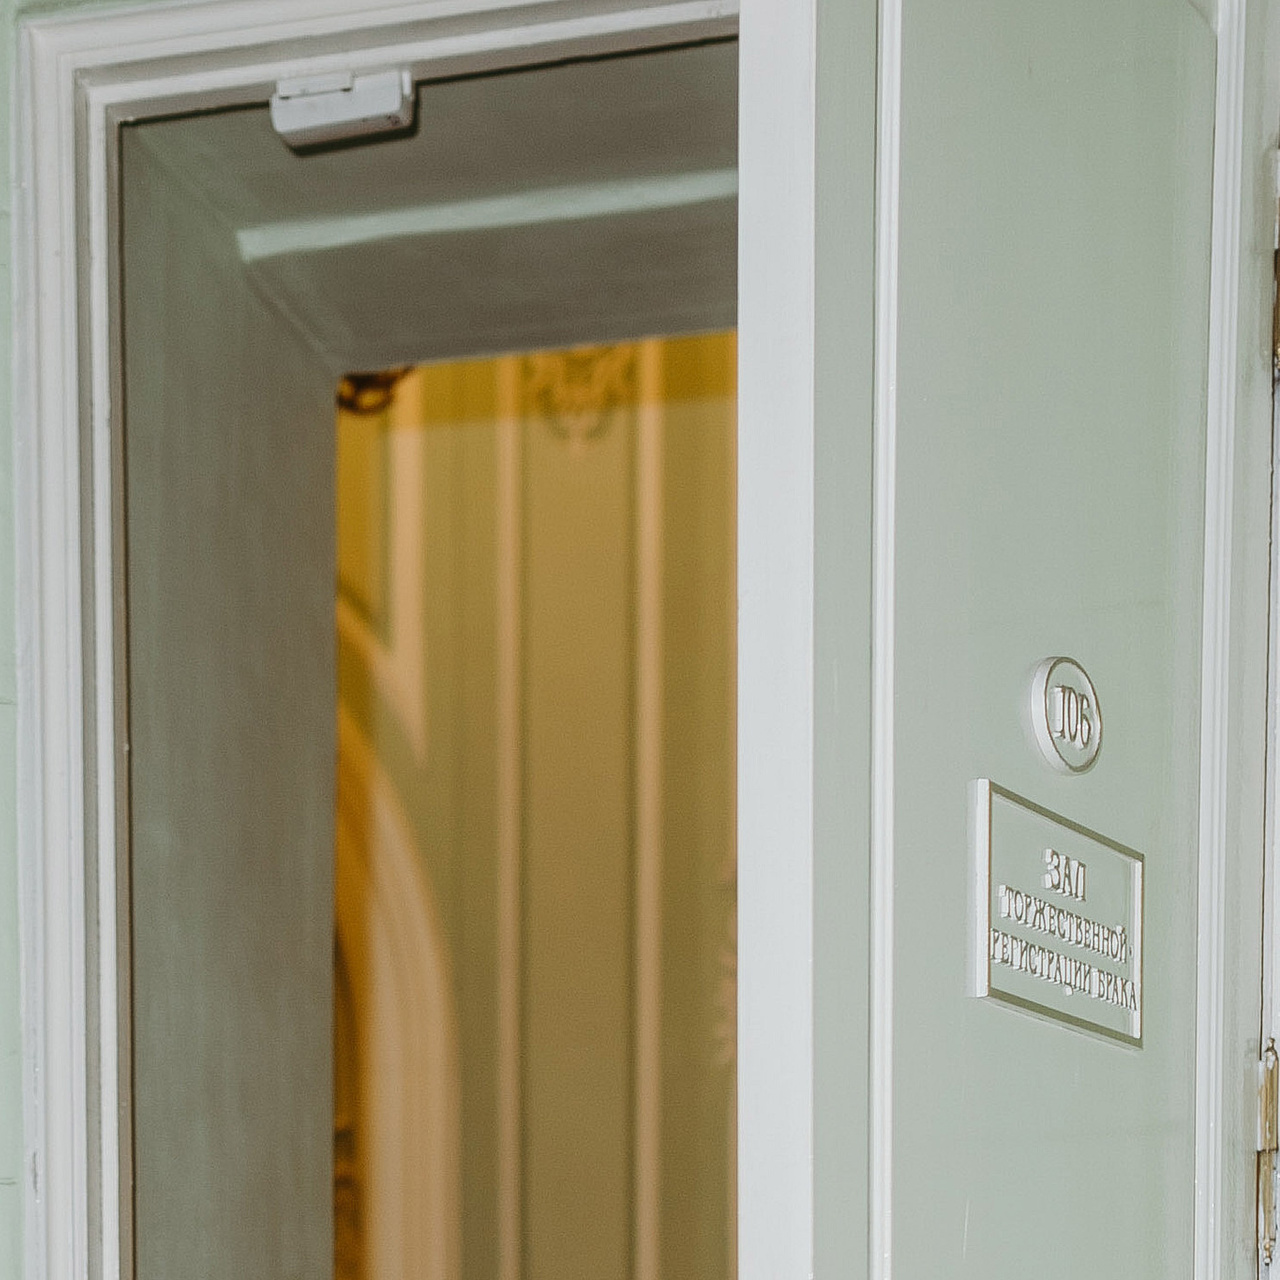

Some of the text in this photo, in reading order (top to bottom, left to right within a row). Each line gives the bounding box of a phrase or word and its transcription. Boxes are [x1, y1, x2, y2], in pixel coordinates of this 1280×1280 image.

[1054, 684, 1091, 750] 106
[1045, 848, 1086, 901] ЗАЛ
[1000, 884, 1127, 963] ТОРЖЕСТВЕННОЙ
[991, 927, 1137, 1011] РЕГИСТРАЦИИ БРАКА
